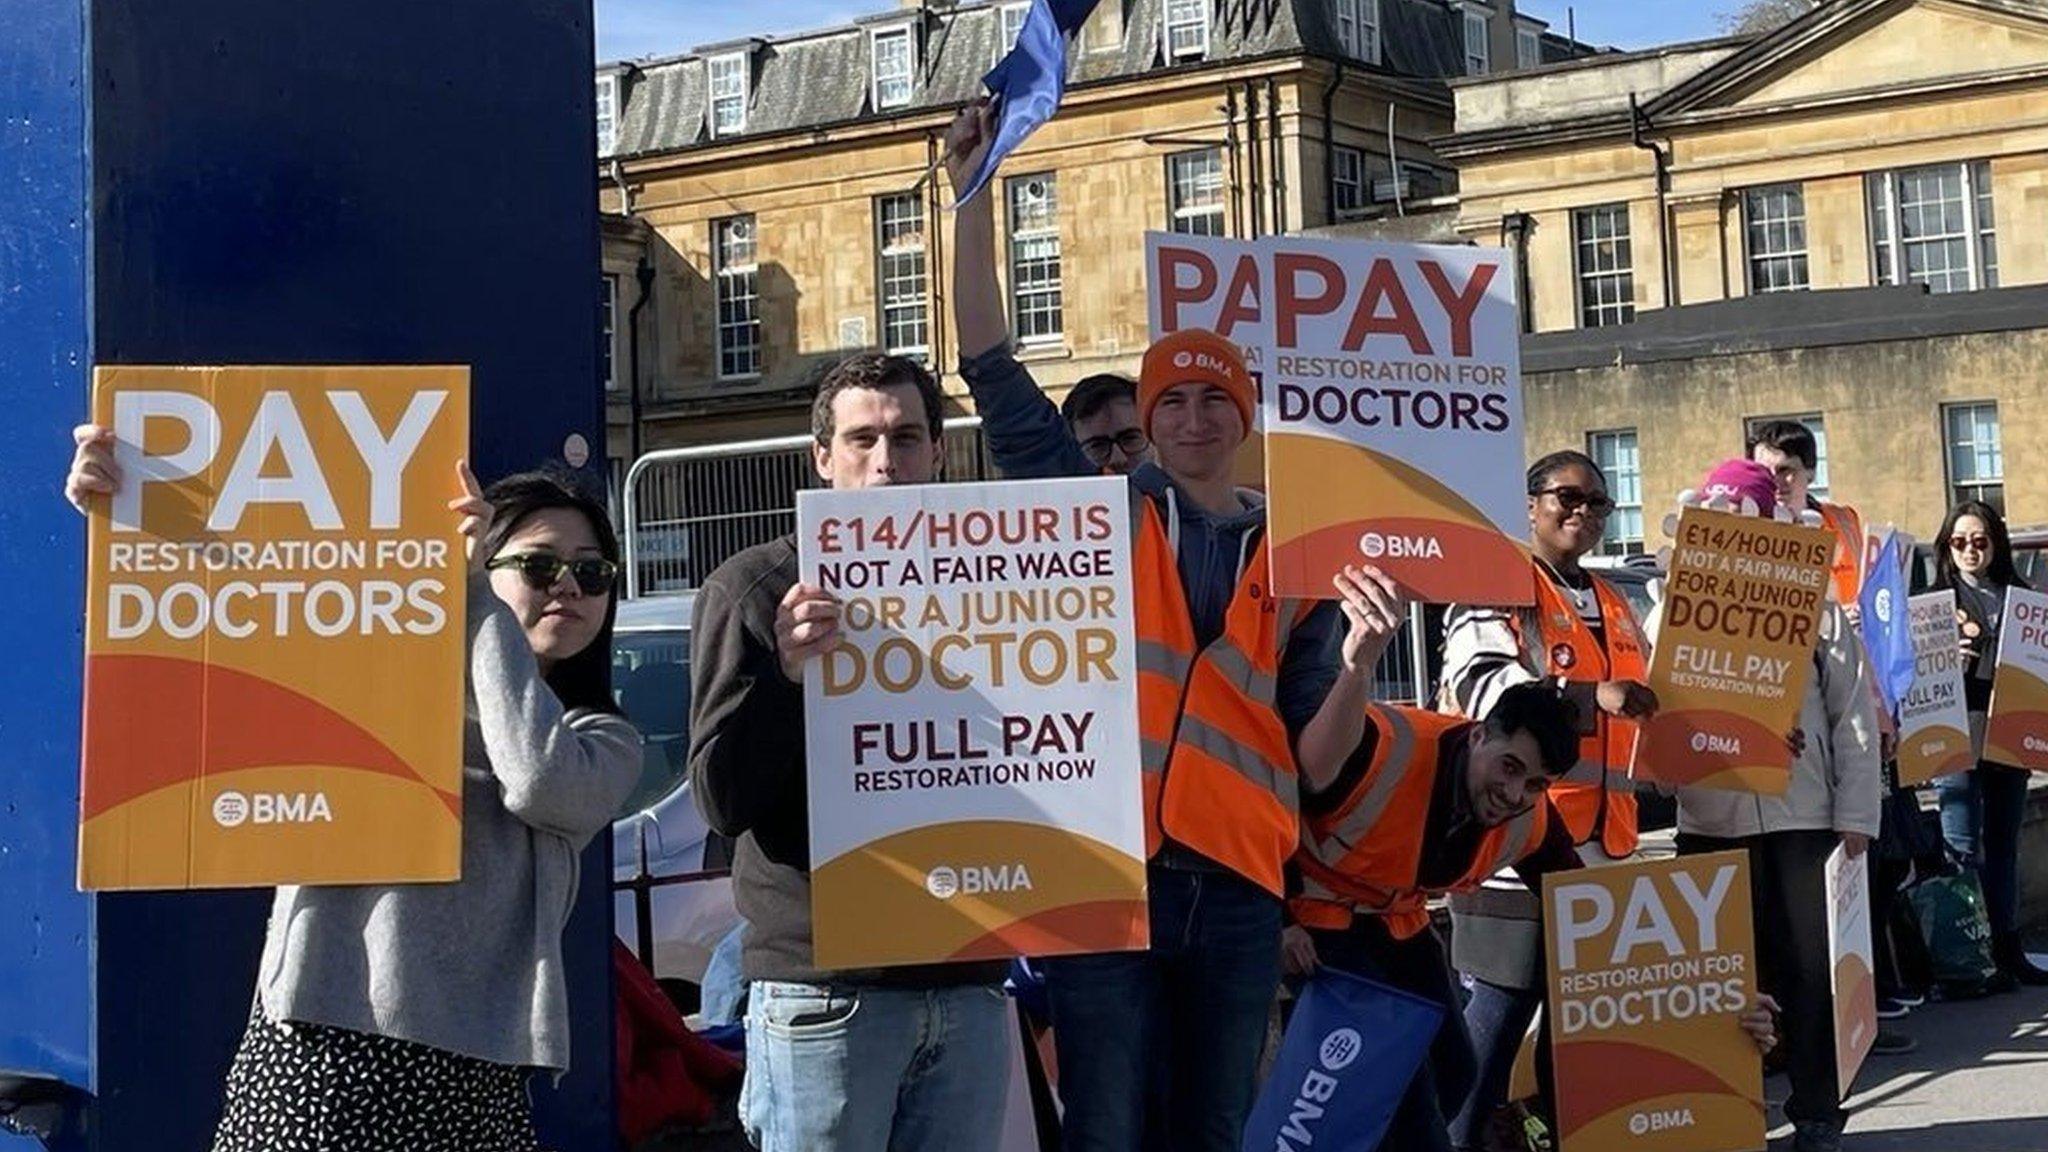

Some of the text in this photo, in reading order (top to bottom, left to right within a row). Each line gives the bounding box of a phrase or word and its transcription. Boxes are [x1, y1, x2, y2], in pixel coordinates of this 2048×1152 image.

[1158, 247, 1261, 338] PA
[1273, 252, 1500, 358] PAY
[1196, 353, 1232, 378] BMA
[1277, 356, 1507, 385] RESTORATION FOR
[1278, 383, 1510, 433] DOCTORS
[111, 390, 450, 532] PAY
[817, 505, 1112, 554] £14/HOUR IS
[1387, 535, 1444, 559] BMA
[1685, 524, 1826, 566] £14/HOUR IS
[109, 540, 448, 572] RESTORATION FOR
[818, 549, 1115, 590] NOT A FAIR WAGE
[1680, 550, 1714, 570] NOT
[1719, 557, 1731, 572] A
[1733, 557, 1773, 578] FAIR
[1774, 565, 1822, 588] WAGE
[106, 578, 447, 639] DOCTORS
[836, 585, 1117, 632] OR A JUNIOR
[1674, 570, 1818, 610] FOR A JUNIOR
[1669, 595, 1812, 647] DOCTOR
[822, 628, 1120, 697] DOCTOR
[1673, 645, 1792, 684] FULL PAY
[1915, 650, 1958, 677] CTOR
[1670, 671, 1786, 699] RESTORATION NOW
[1933, 682, 1956, 700] PAY
[853, 712, 1095, 765] FULL PAY
[1706, 735, 1740, 755] BMA
[854, 759, 1096, 792] RESTORATION NOW
[253, 792, 333, 823] BMA
[962, 866, 1032, 893] BMA
[1553, 864, 1738, 970] PAY
[1560, 953, 1745, 994] RESTORATION FOR
[1562, 977, 1746, 1033] DOCTORS
[1652, 1108, 1696, 1131] BMA
